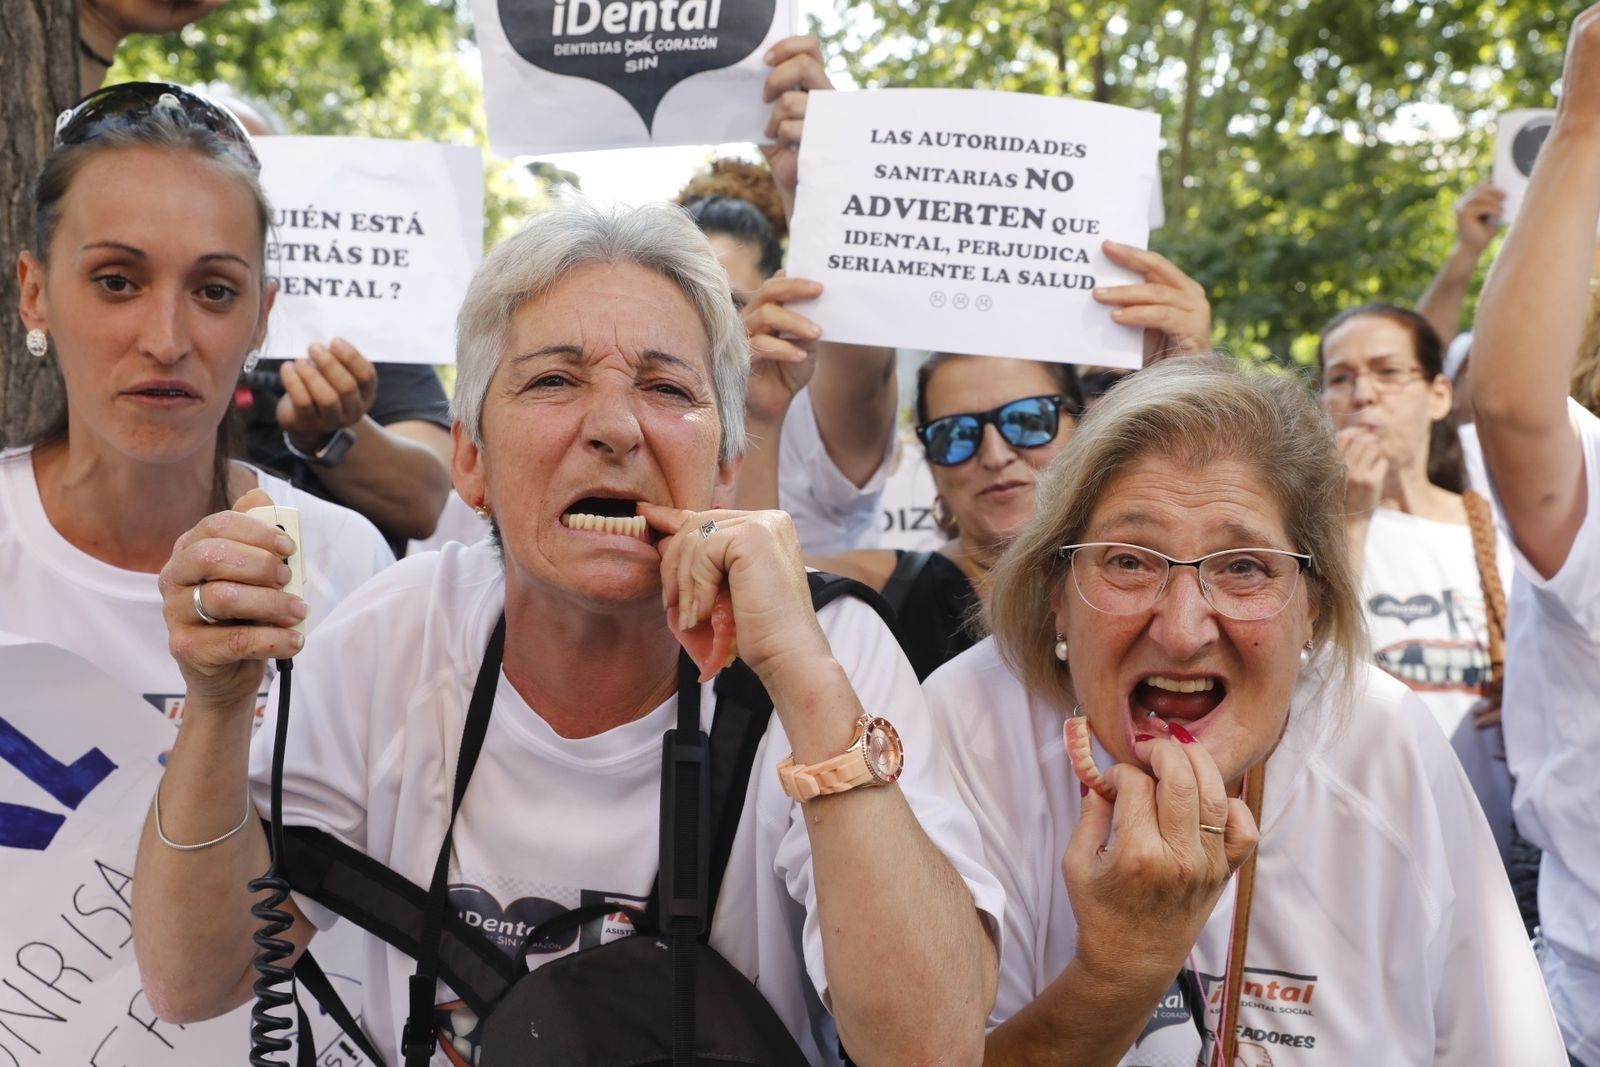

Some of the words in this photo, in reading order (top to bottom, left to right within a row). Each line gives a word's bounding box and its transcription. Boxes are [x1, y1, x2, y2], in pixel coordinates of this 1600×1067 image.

[552, 0, 722, 36] iDental
[554, 40, 622, 56] DENTISTAS
[655, 35, 718, 52] CORAZÓN
[624, 55, 659, 73] SIN
[870, 129, 912, 145] LAS
[917, 131, 1087, 159] AUTORIDADES
[874, 164, 1018, 188] SANITARIAS
[1024, 167, 1075, 192] NO
[269, 204, 341, 230] UIÉN
[350, 211, 425, 236] ESTÁ
[842, 194, 1047, 230] ADVIERTEN
[1052, 216, 1100, 235] QUE
[265, 240, 363, 265] ETRÁS
[371, 247, 410, 268] DE
[843, 229, 951, 255] IDENTAL,
[957, 238, 1091, 264] PERJUDICA
[827, 254, 976, 281] SERIAMENTE
[981, 266, 1011, 284] LA
[1016, 270, 1096, 290] SALUD
[264, 276, 384, 299] DENTAL
[390, 282, 403, 300] ?
[497, 935, 517, 947] SIN
[1240, 1001, 1277, 1014] DENTAL
[1279, 1006, 1315, 1017] SOCIAL
